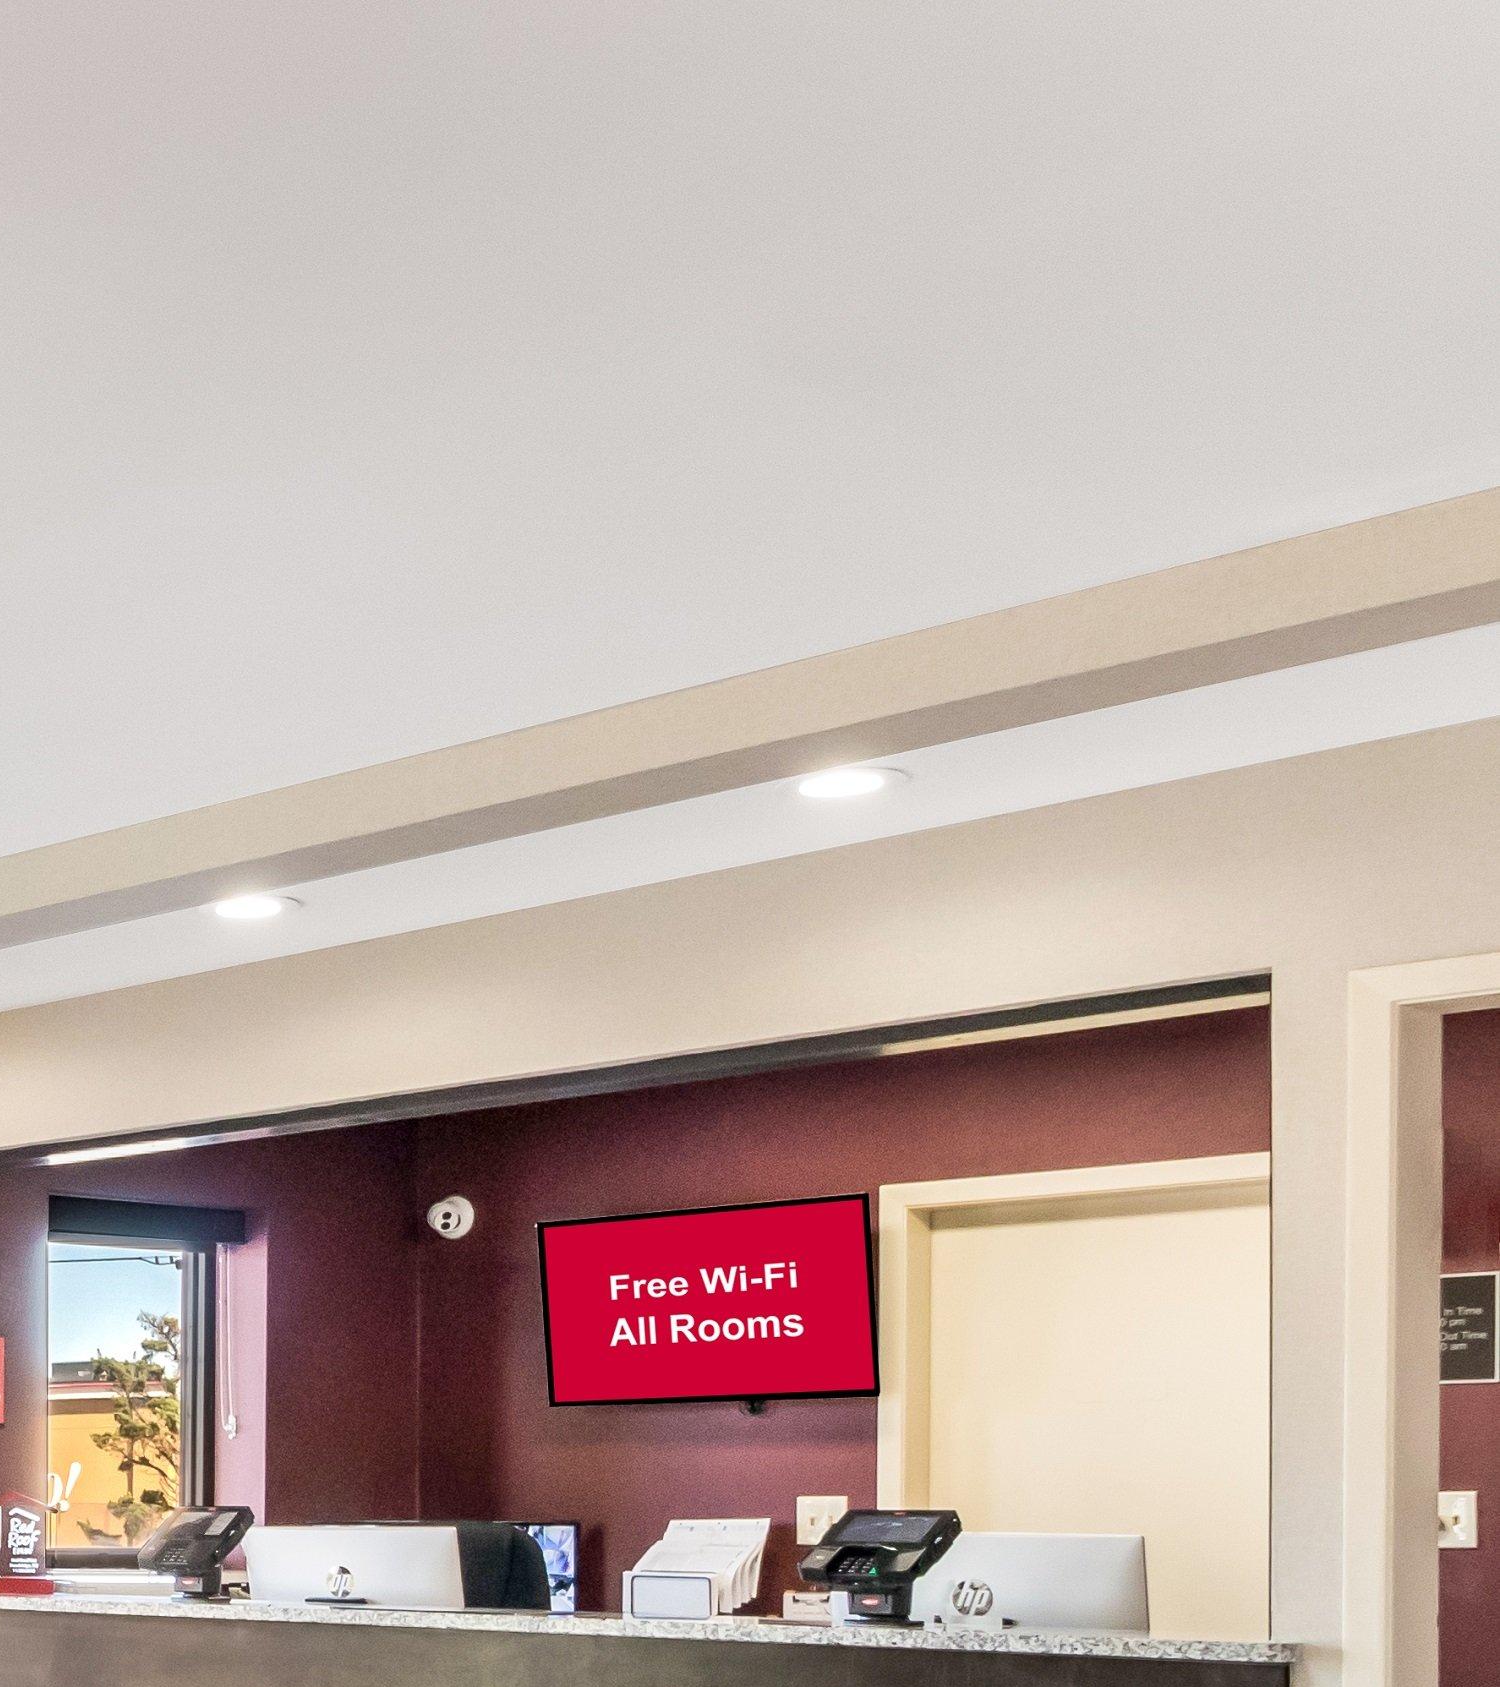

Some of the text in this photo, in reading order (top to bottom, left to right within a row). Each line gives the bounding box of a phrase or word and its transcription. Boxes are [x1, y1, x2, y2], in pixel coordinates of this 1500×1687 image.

[609, 1261, 798, 1300] Free Wi-Fi
[610, 1313, 805, 1347] All Rooms
[8, 1530, 41, 1549] Roof
[952, 1580, 993, 1616] hp
